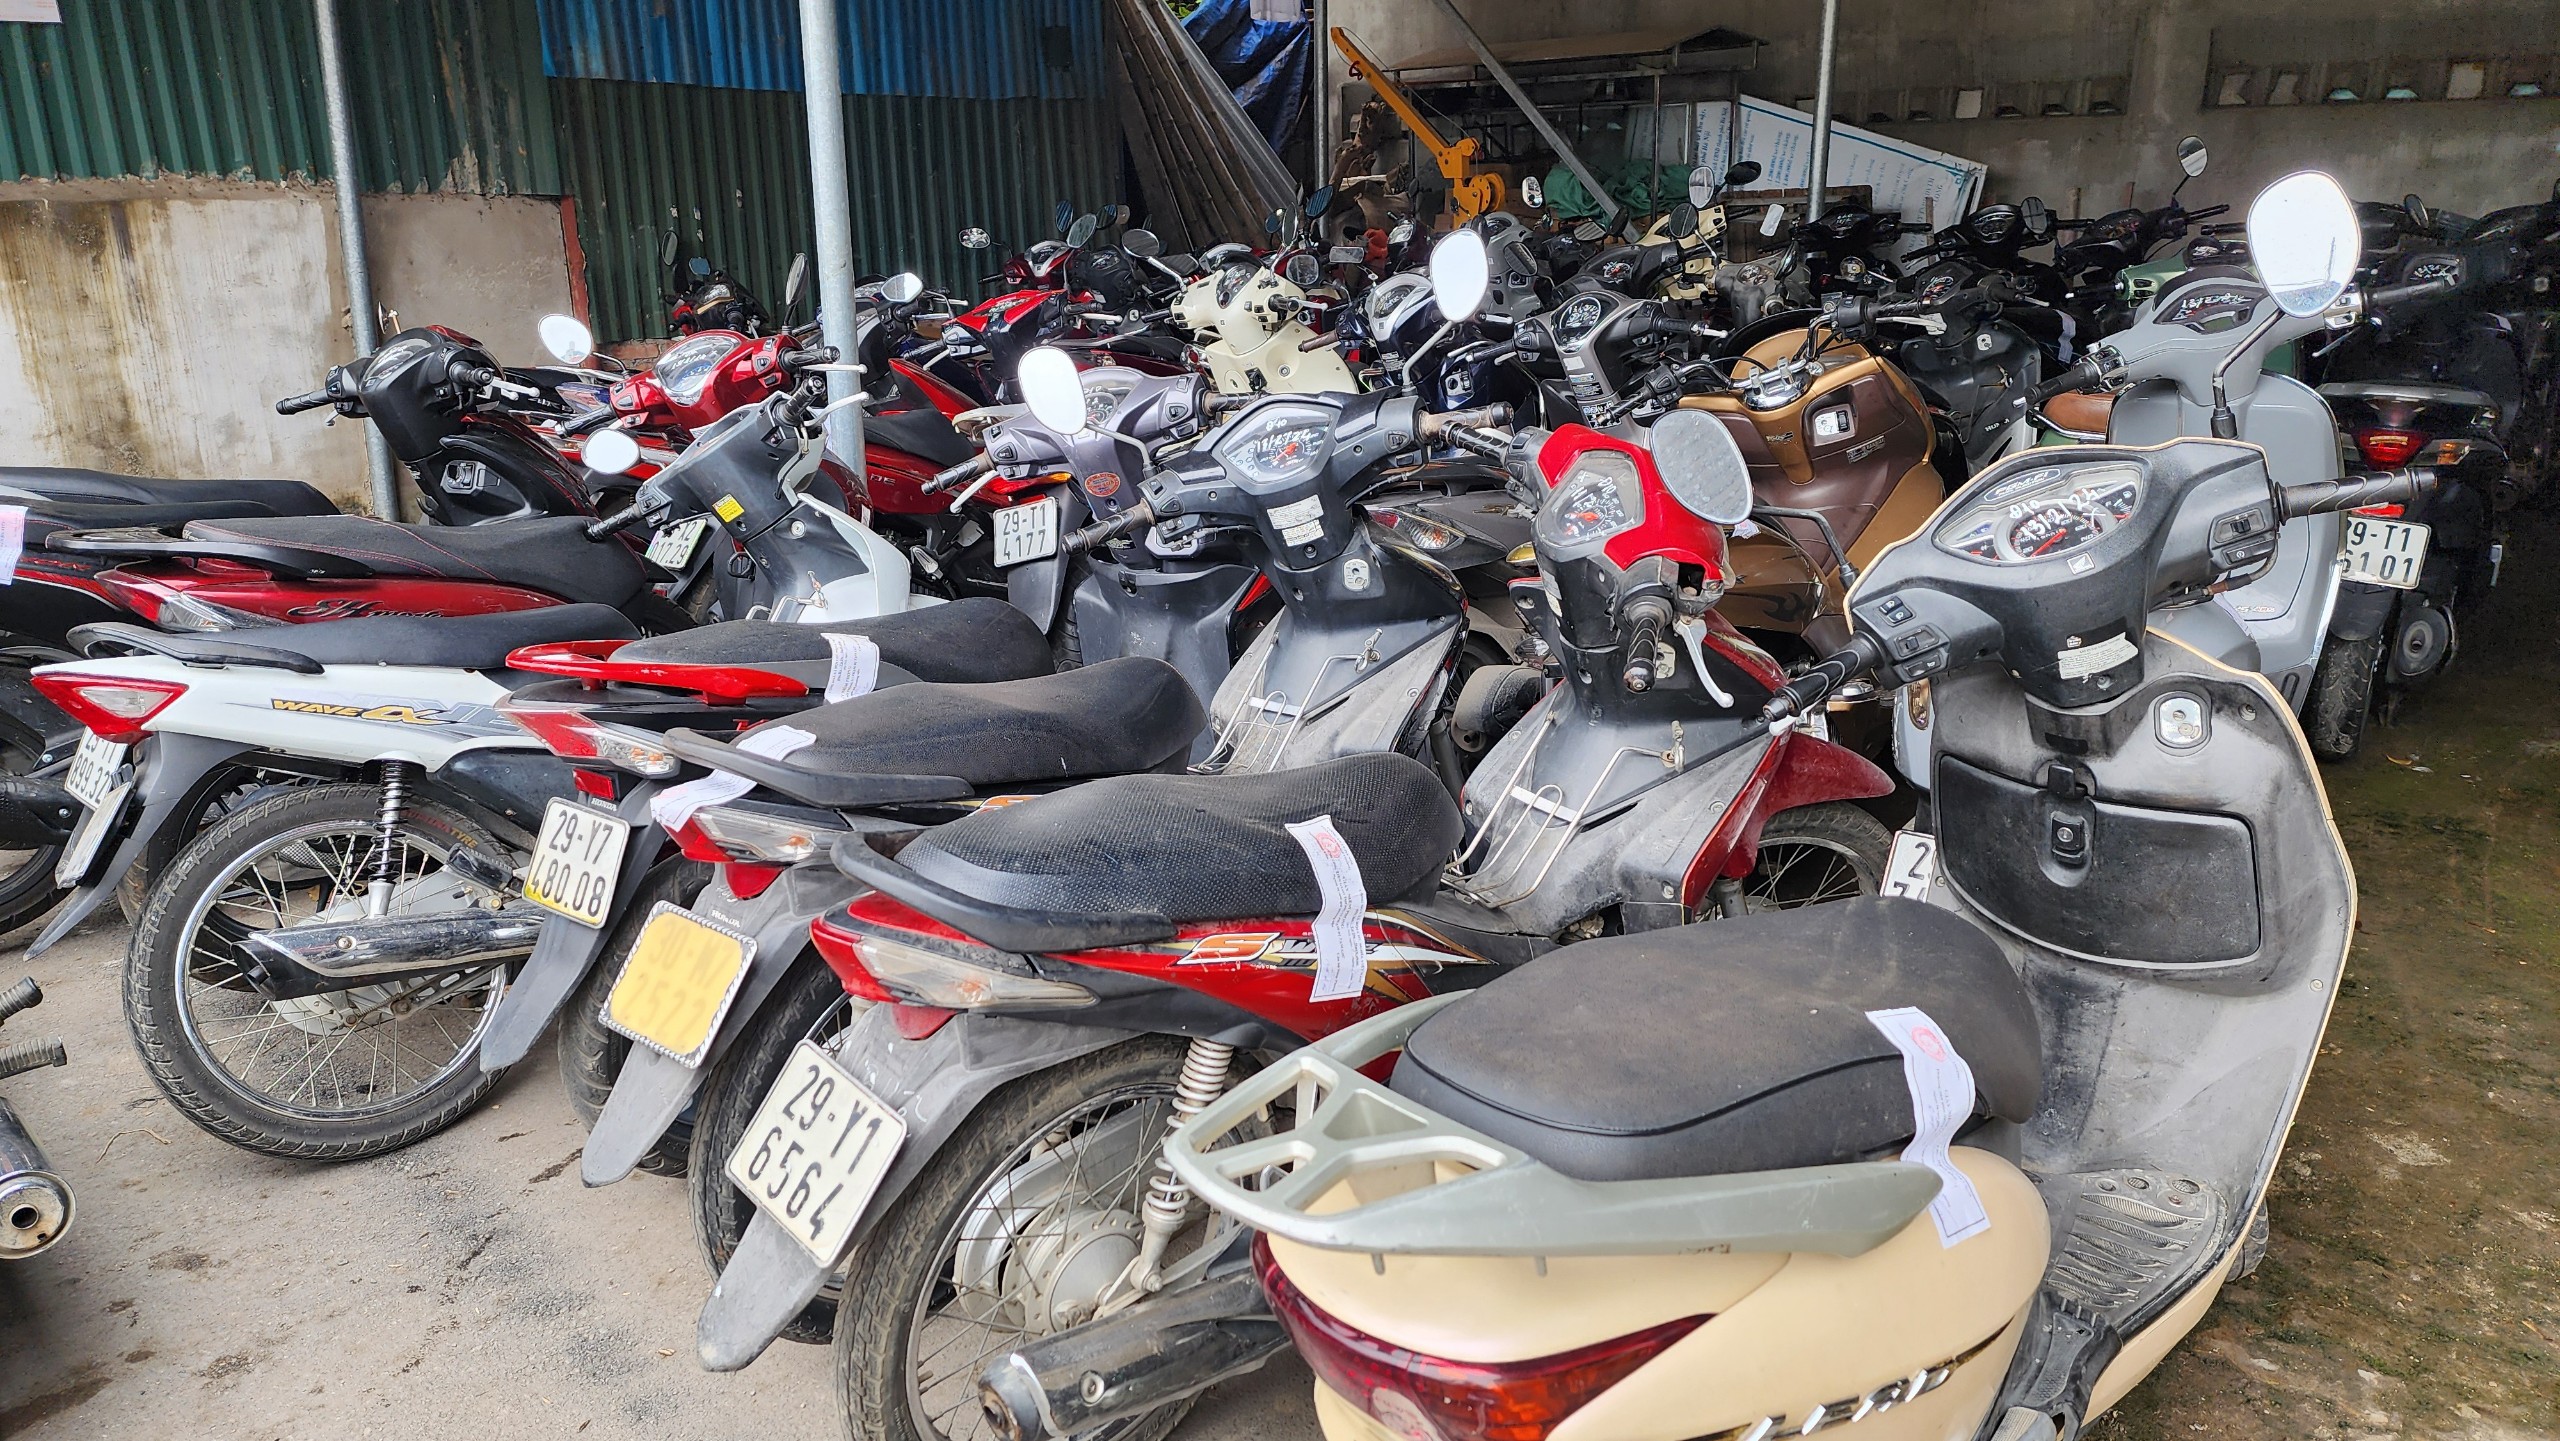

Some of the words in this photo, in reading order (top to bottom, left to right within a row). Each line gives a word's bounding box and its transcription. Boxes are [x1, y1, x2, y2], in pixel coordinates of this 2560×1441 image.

[1002, 503, 1047, 536] 29-T1
[2347, 521, 2411, 552] 9-T1
[1002, 529, 1047, 561] 4177
[271, 698, 360, 718] WAVE
[548, 809, 614, 865] 29-Y7
[530, 853, 606, 917] 480.08
[782, 1064, 883, 1176] 29-Y1
[748, 1126, 844, 1242] 6564
